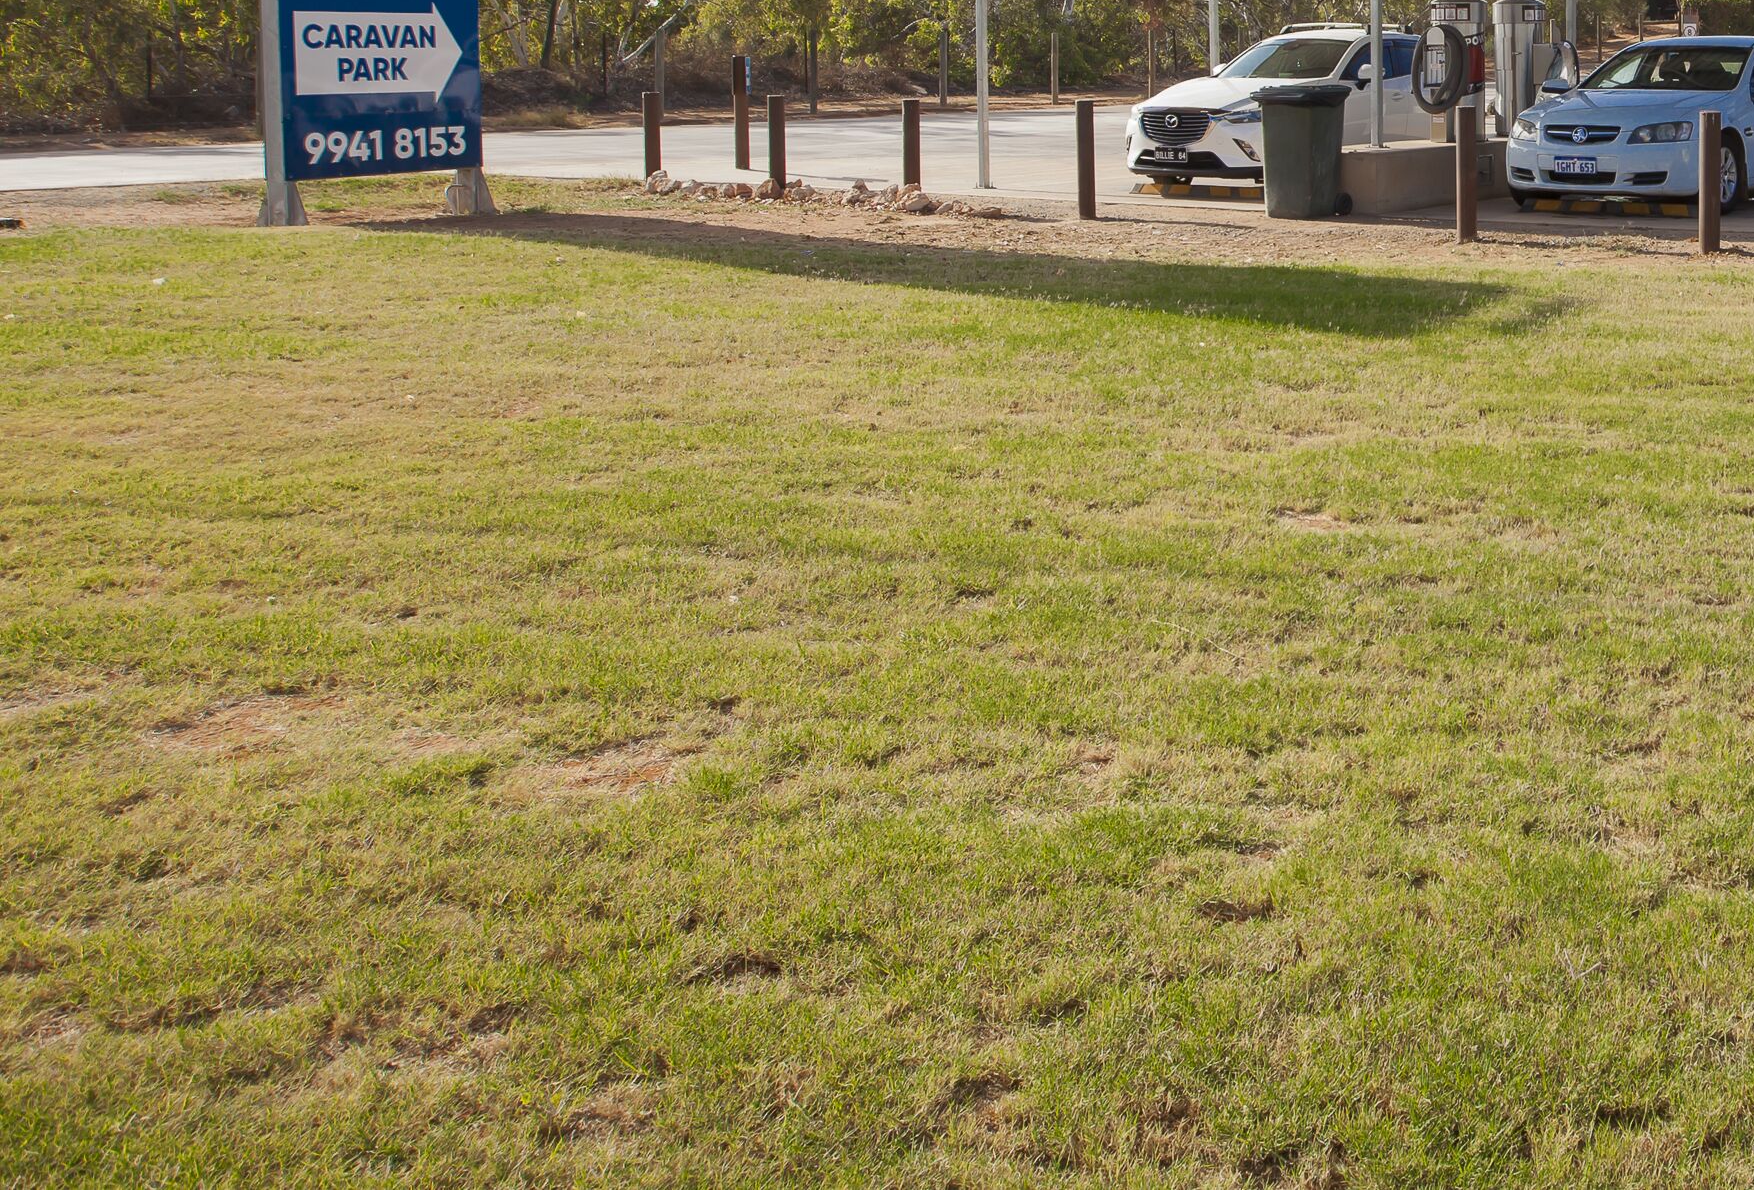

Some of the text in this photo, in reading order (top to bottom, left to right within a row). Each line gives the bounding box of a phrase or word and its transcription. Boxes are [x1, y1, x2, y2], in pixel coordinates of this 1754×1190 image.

[303, 23, 437, 50] CARAVAN
[338, 57, 408, 82] PARK
[304, 125, 466, 165] 9941 8153
[1556, 161, 1595, 173] 1GHT 653
